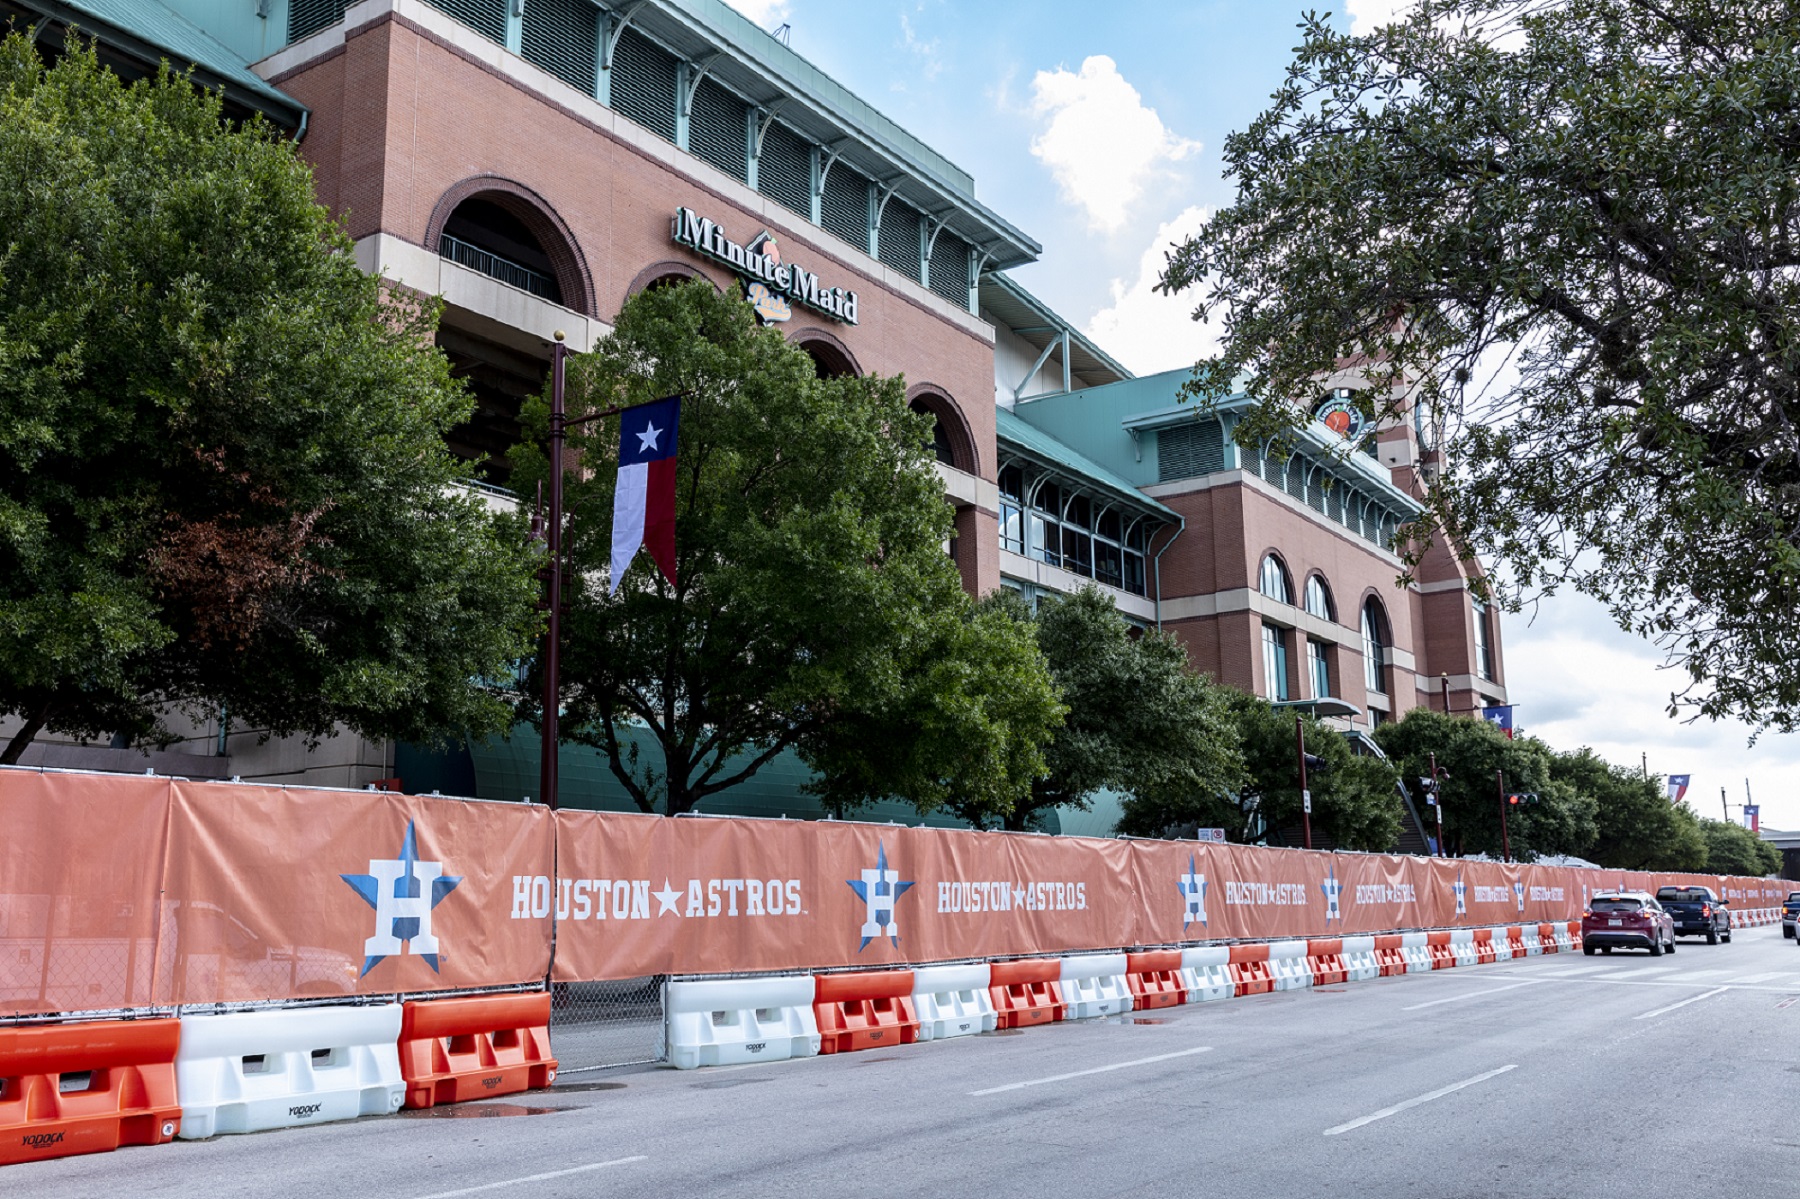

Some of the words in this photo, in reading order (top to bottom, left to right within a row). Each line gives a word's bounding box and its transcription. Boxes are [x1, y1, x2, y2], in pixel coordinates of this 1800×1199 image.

[677, 207, 790, 289] Minute
[791, 264, 859, 325] Maid
[749, 282, 790, 314] Park
[365, 859, 443, 956] H
[511, 875, 650, 920] HOUSTON
[685, 879, 801, 917] ASTROS
[861, 869, 898, 937] H
[937, 882, 1011, 913] HOUSTON
[1026, 882, 1086, 911] ASTROS
[1181, 874, 1208, 922] H
[1226, 881, 1268, 905] HOUSTON
[1276, 883, 1306, 905] ASTROS
[289, 1102, 322, 1116] YODOCK
[22, 1131, 66, 1146] YODOCK
